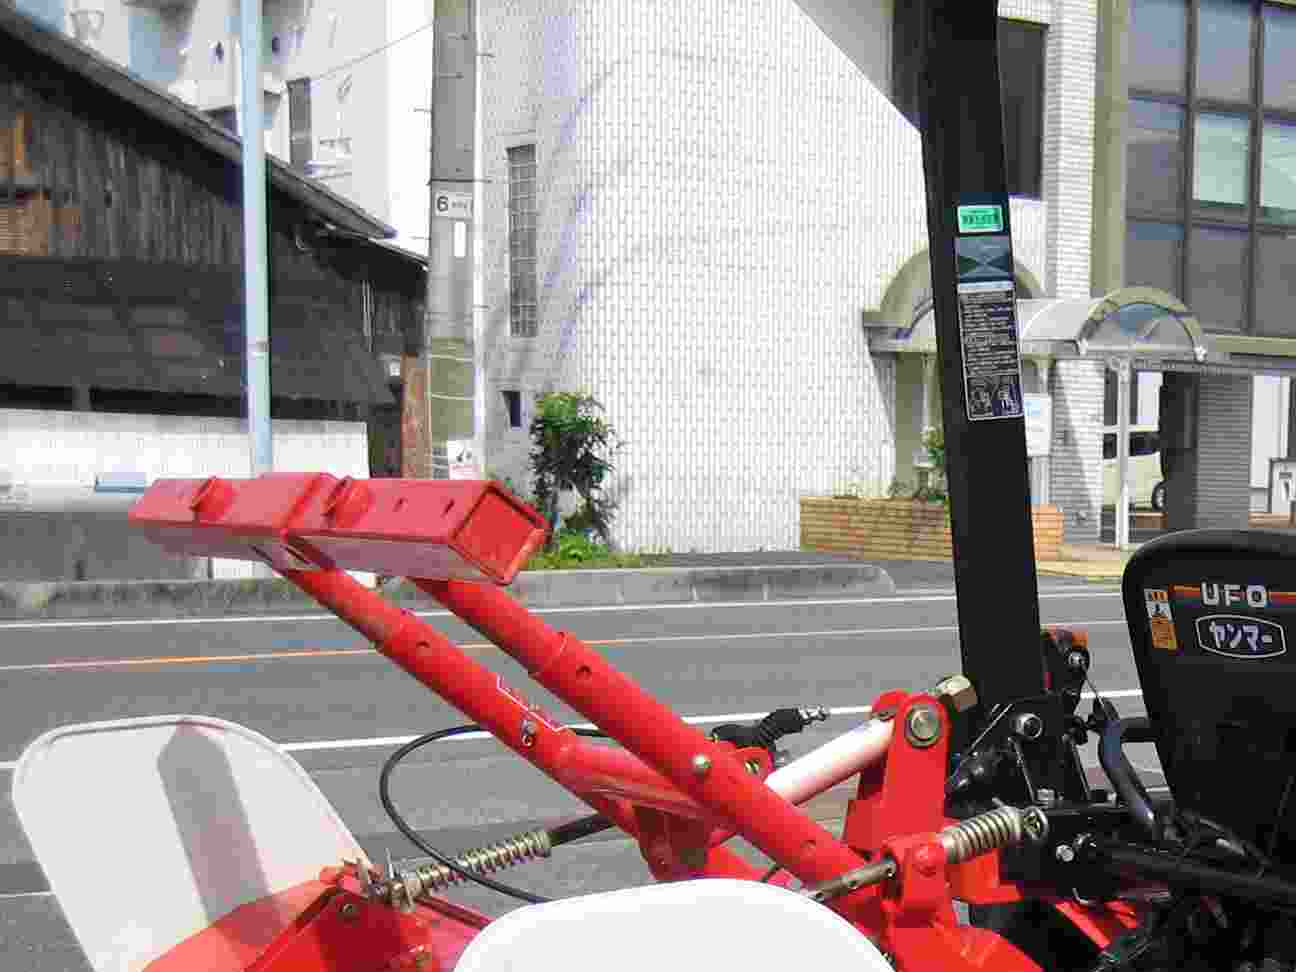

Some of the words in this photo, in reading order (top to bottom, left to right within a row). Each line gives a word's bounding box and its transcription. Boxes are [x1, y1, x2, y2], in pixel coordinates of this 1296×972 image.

[1201, 582, 1267, 608] UFO
[1209, 620, 1273, 651] ヤンマー
